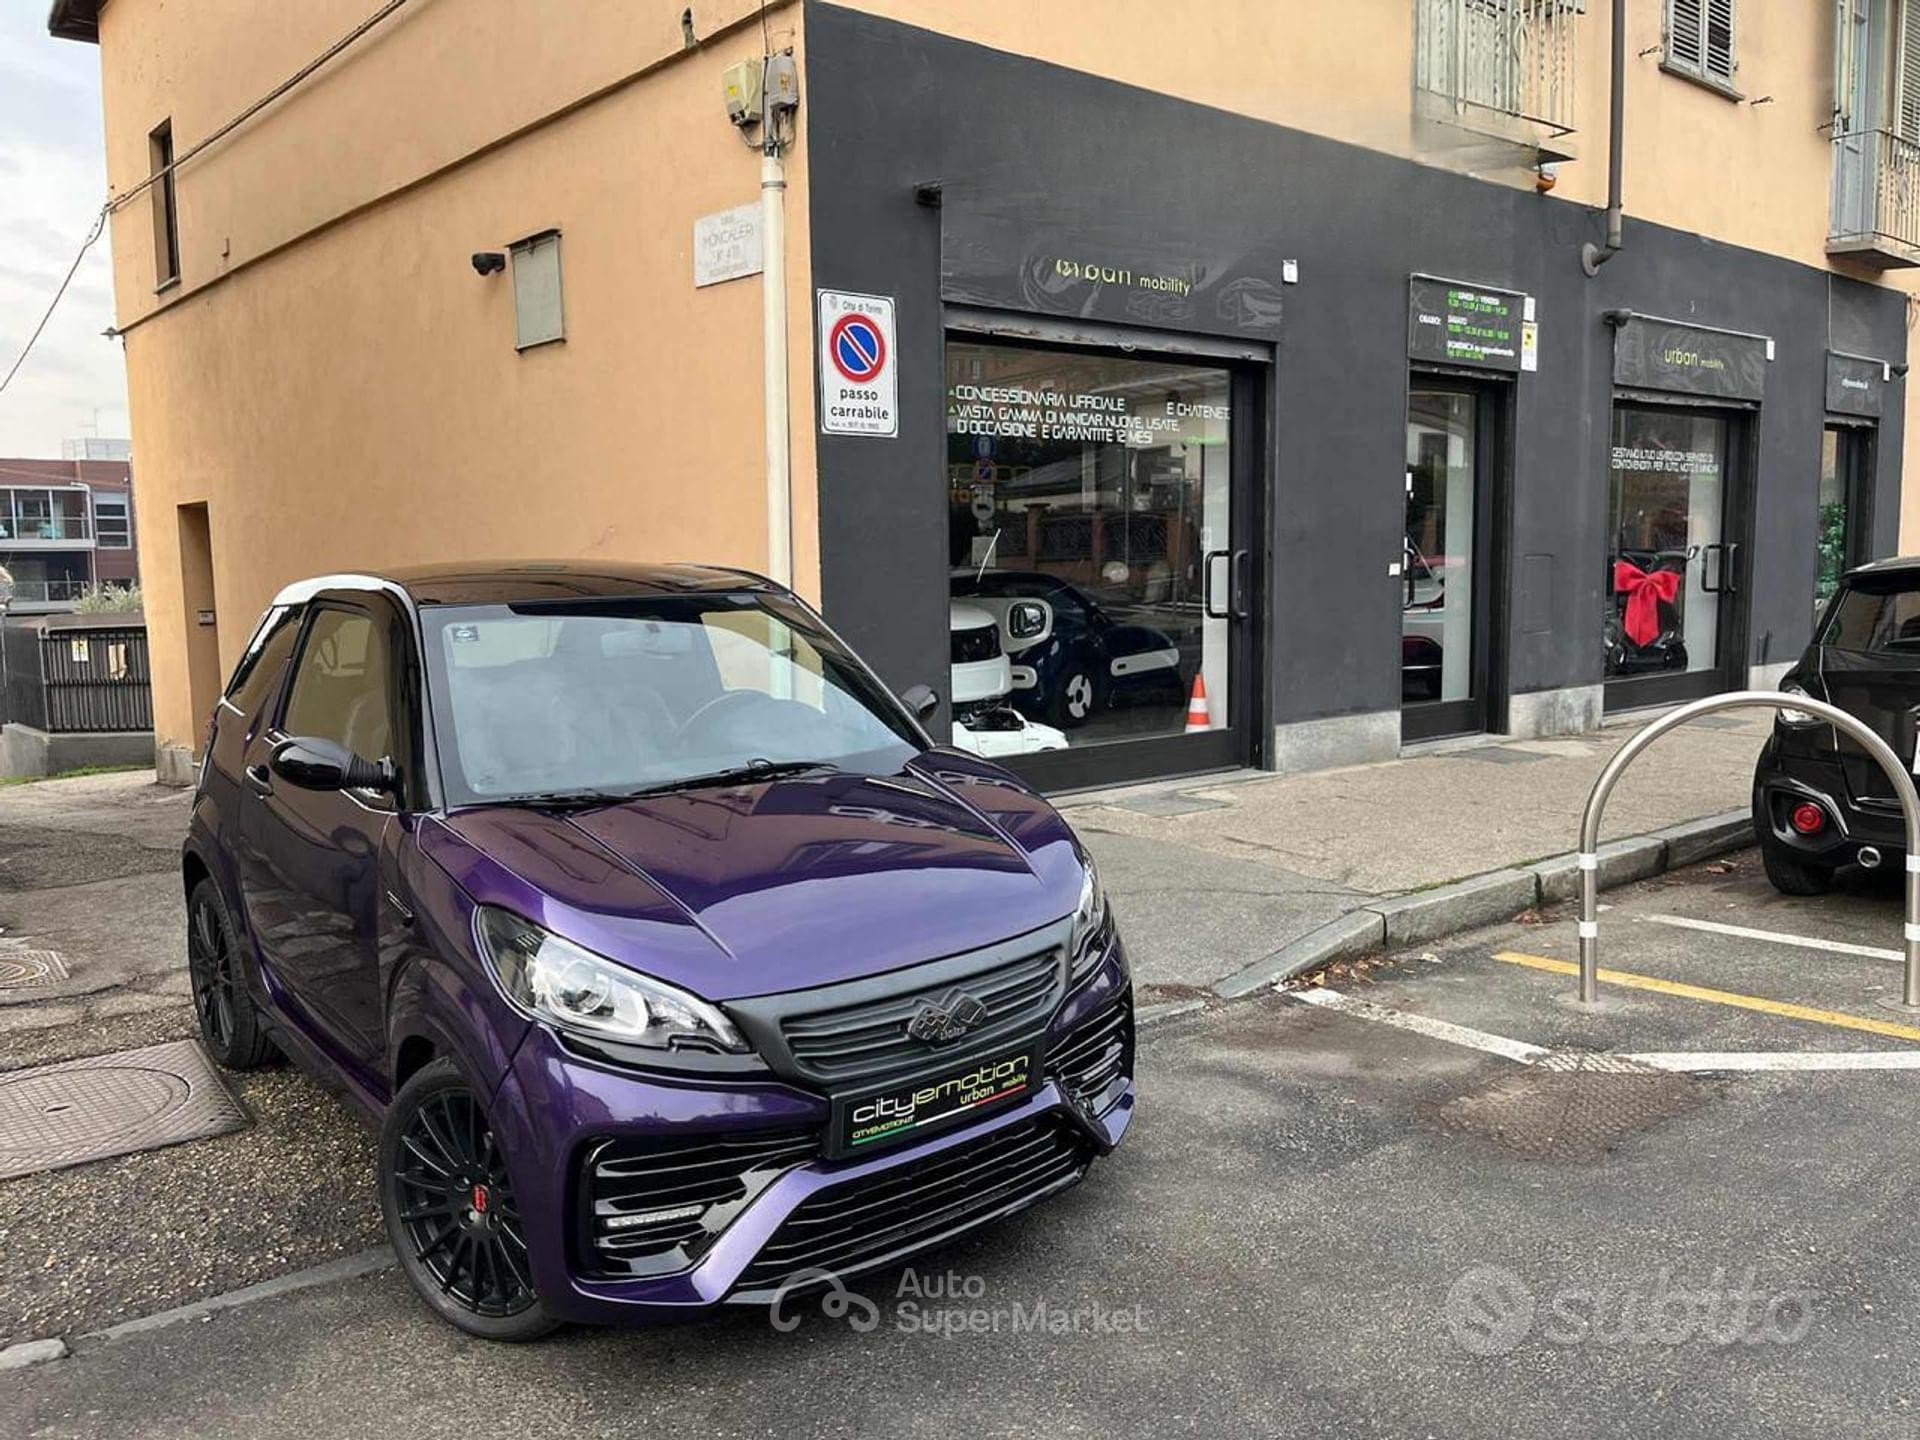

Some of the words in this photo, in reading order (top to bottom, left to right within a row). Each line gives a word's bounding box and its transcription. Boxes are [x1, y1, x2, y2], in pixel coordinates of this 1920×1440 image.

[1140, 276, 1190, 297] mobility
[1664, 348, 1698, 366] urban
[840, 388, 878, 401] passo
[956, 385, 1066, 407] CONCESSIONARIA
[1070, 394, 1125, 411] UFFICIALE
[1167, 402, 1175, 415] E
[830, 406, 889, 420] carrabile
[957, 404, 995, 419] VASTA
[999, 407, 1043, 422] GAMMA
[1046, 410, 1057, 424] DI
[1060, 412, 1103, 427] MINICAR
[1042, 425, 1050, 438] E
[1052, 425, 1113, 442] GARANTITE
[1116, 429, 1126, 443] 12
[1127, 430, 1153, 443] MESI
[853, 1055, 1029, 1122] cityemotion
[960, 1085, 995, 1104] urban
